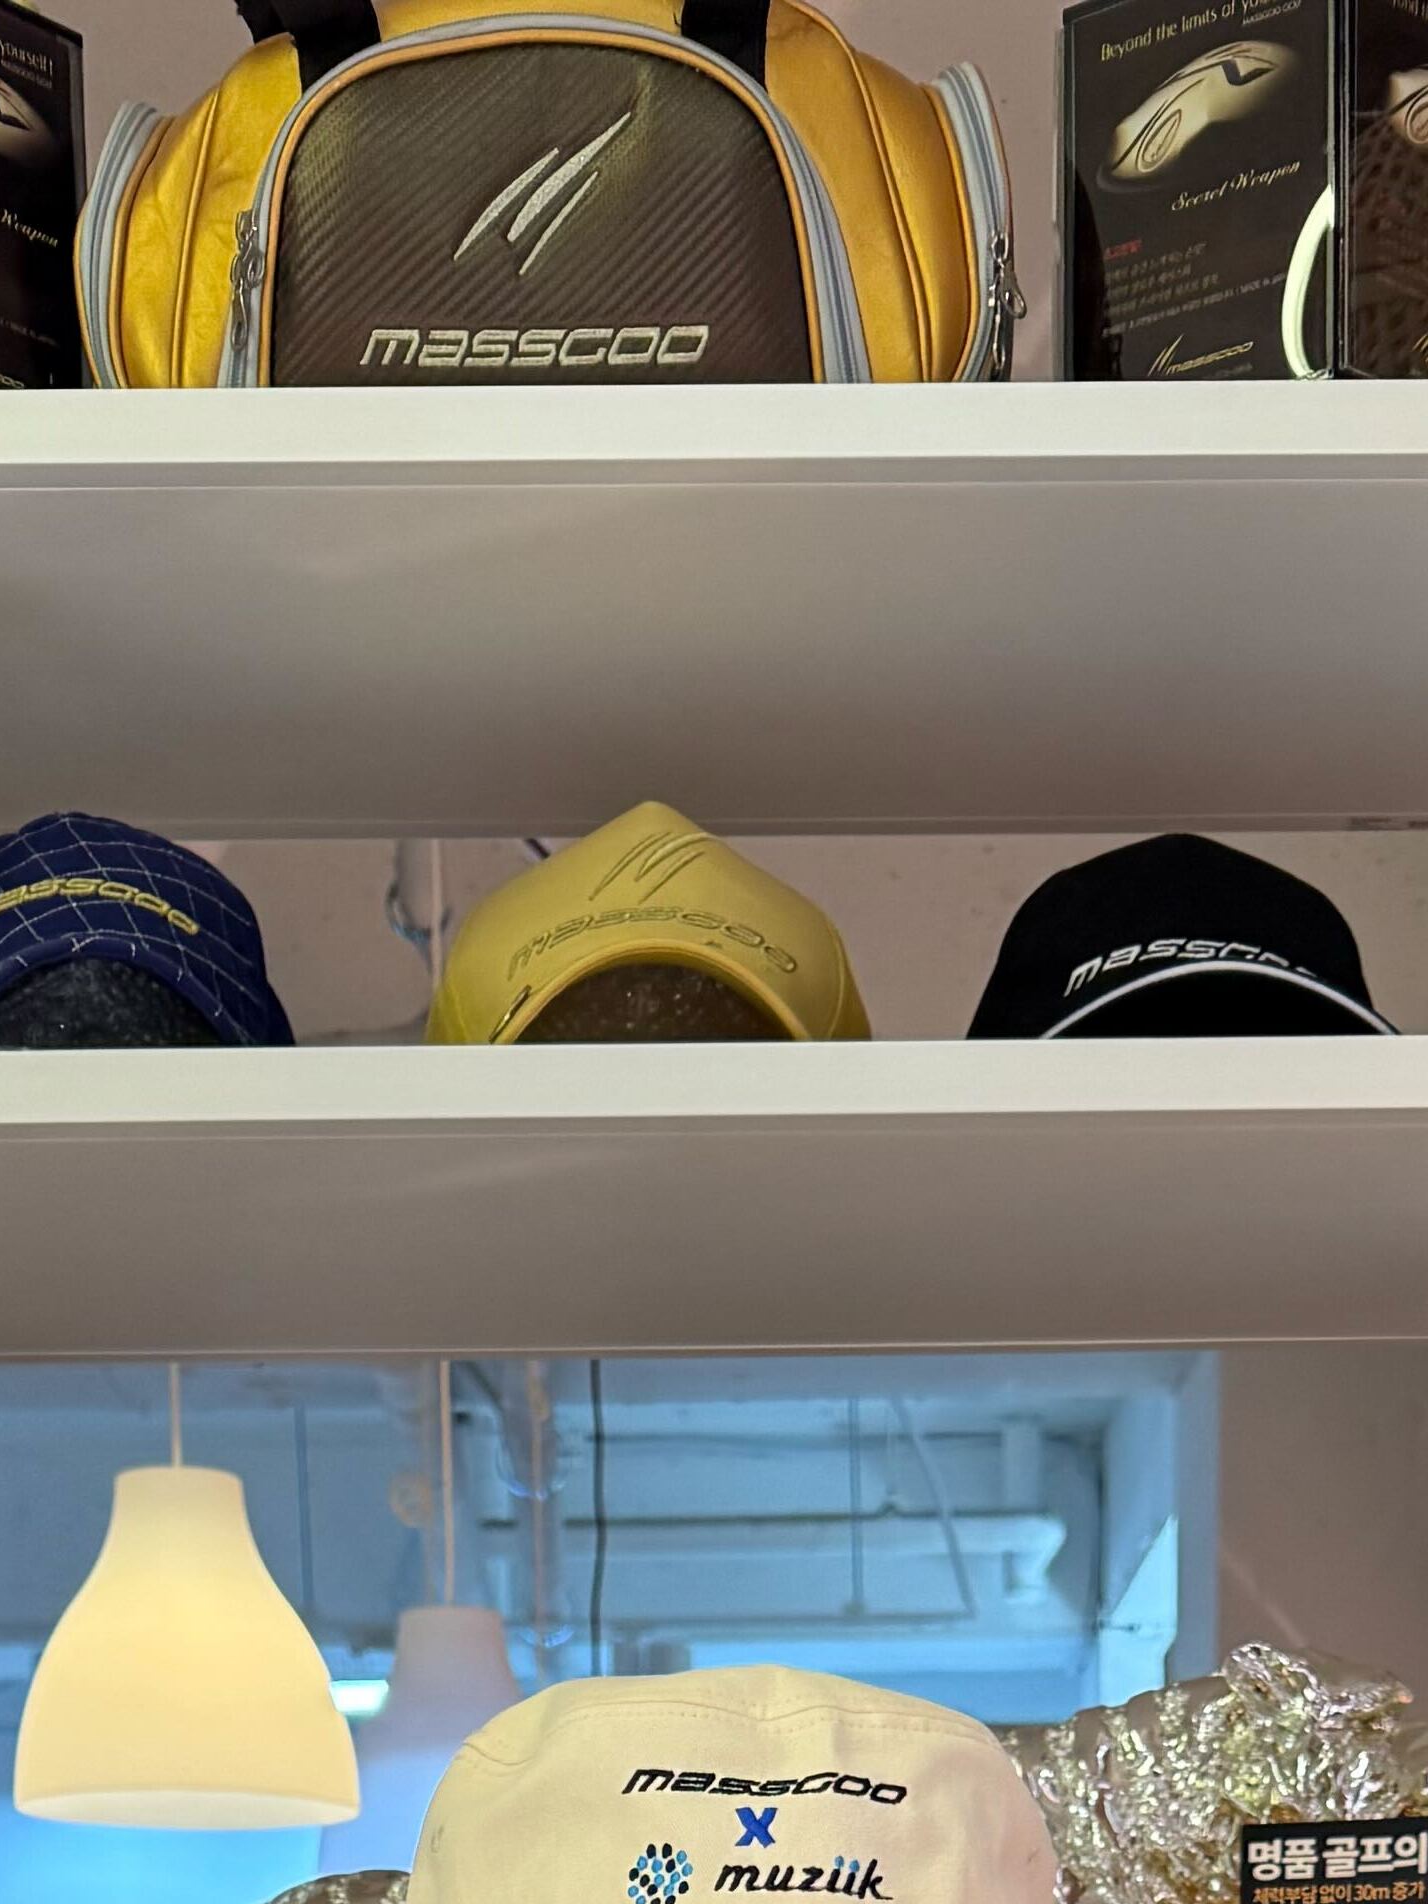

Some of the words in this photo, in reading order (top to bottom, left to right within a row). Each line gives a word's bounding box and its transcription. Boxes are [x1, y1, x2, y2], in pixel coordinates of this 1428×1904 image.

[1101, 29, 1153, 62] Beyond
[1247, 1838, 1318, 1881] 명품
[1353, 1883, 1390, 1901] 30m
[1392, 1880, 1426, 1901] 증가
